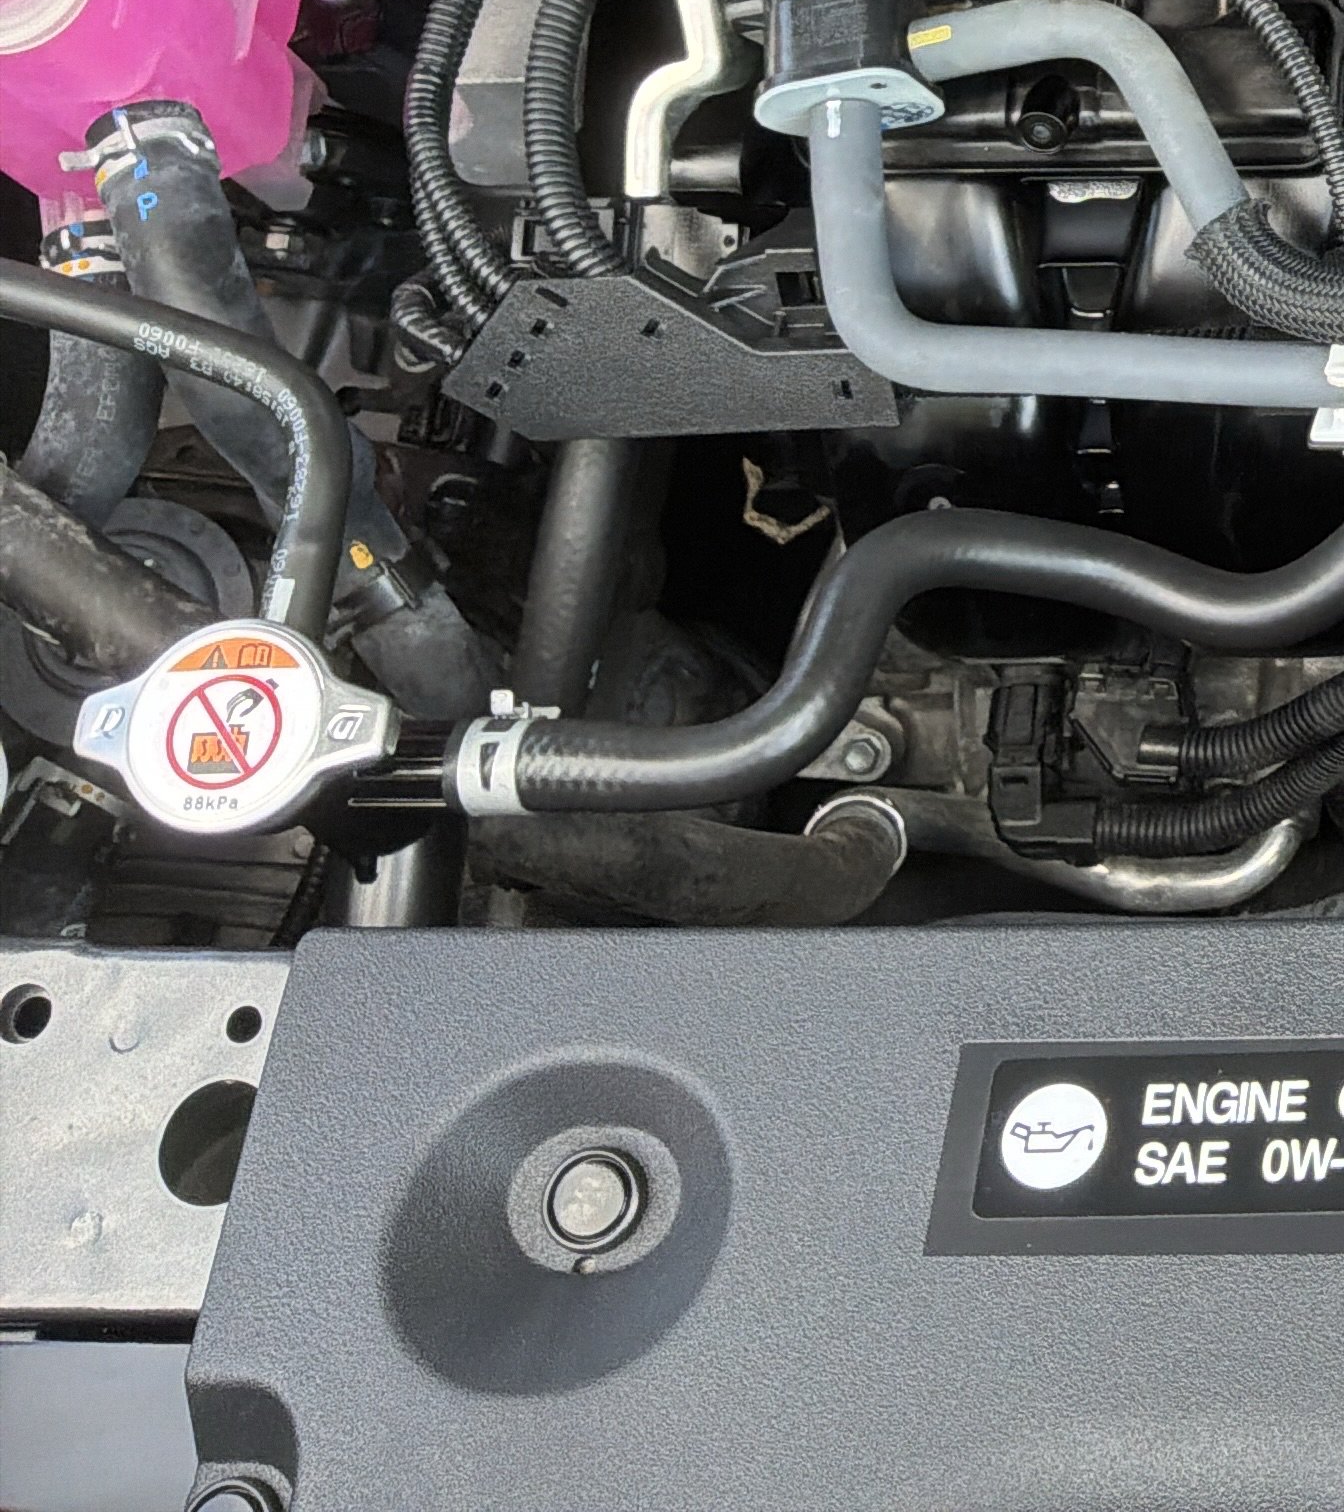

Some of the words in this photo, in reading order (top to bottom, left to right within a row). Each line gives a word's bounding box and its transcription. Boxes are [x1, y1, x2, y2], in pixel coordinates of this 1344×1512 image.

[183, 795, 239, 812] 88kPa
[1142, 1080, 1309, 1125] ENGINE
[1134, 1141, 1229, 1186] SAE
